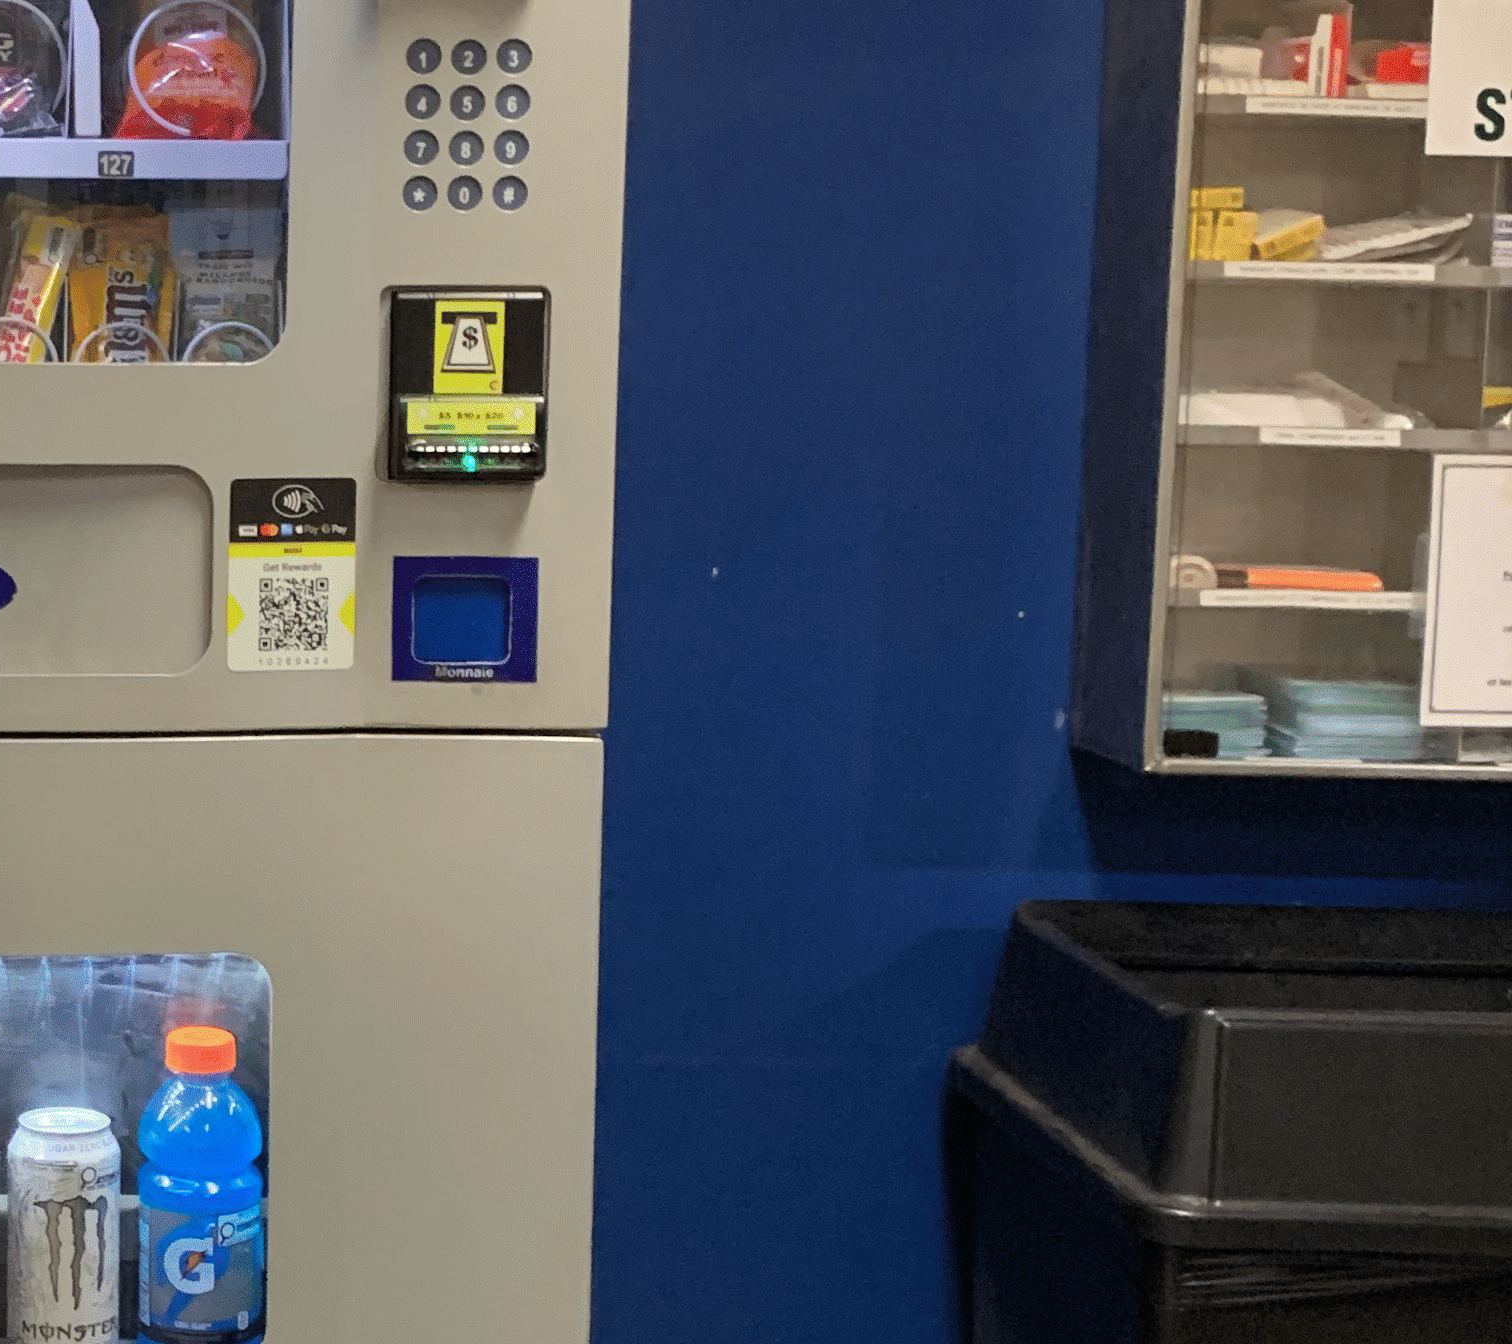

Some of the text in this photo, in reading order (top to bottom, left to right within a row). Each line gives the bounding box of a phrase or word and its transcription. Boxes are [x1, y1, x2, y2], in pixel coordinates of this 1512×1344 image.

[419, 51, 427, 68] 1
[463, 50, 474, 67] 2
[509, 50, 519, 67] 3
[417, 96, 427, 113] 4
[462, 96, 473, 113] 5
[507, 95, 518, 113] 6
[1474, 88, 1512, 142] S
[415, 141, 427, 158] 7
[460, 141, 471, 159] 8
[505, 141, 516, 159] 9
[100, 155, 133, 176] 127
[459, 186, 470, 204] 0
[461, 325, 479, 350] $
[263, 562, 322, 572] Get Rewards
[435, 665, 494, 680] Monnaie
[163, 1237, 215, 1295] G
